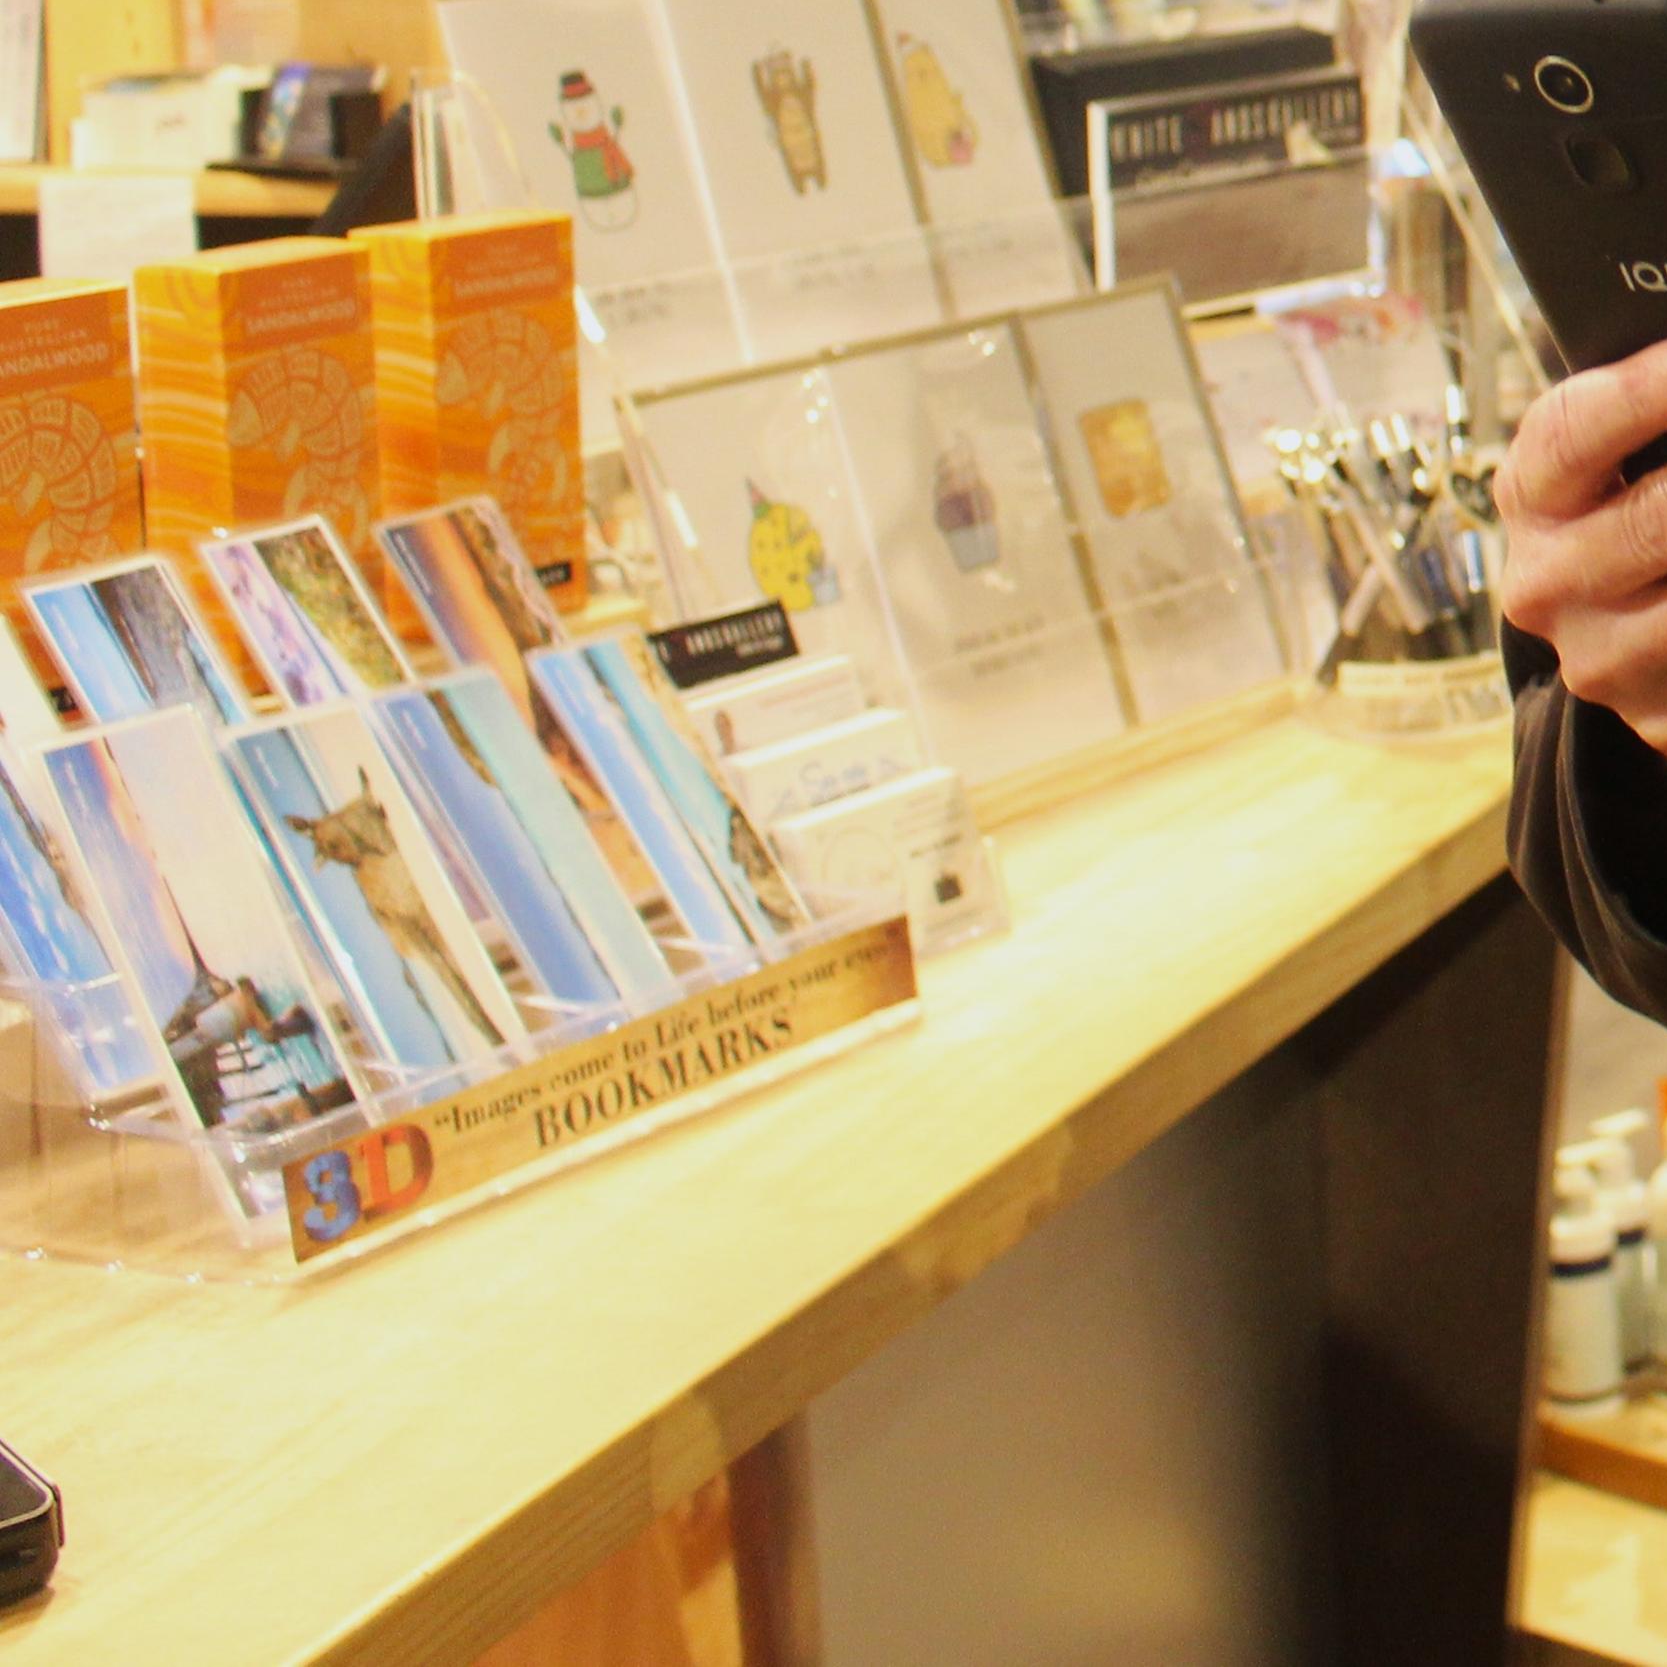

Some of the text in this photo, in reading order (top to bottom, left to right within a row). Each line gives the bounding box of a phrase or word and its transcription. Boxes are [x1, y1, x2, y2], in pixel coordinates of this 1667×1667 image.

[533, 1008, 795, 1149] BOOKMARKS
[547, 1049, 616, 1095] come
[621, 1032, 648, 1059] to
[653, 1010, 702, 1056] Life
[704, 983, 785, 1031] before
[302, 1121, 434, 1243] 3D
